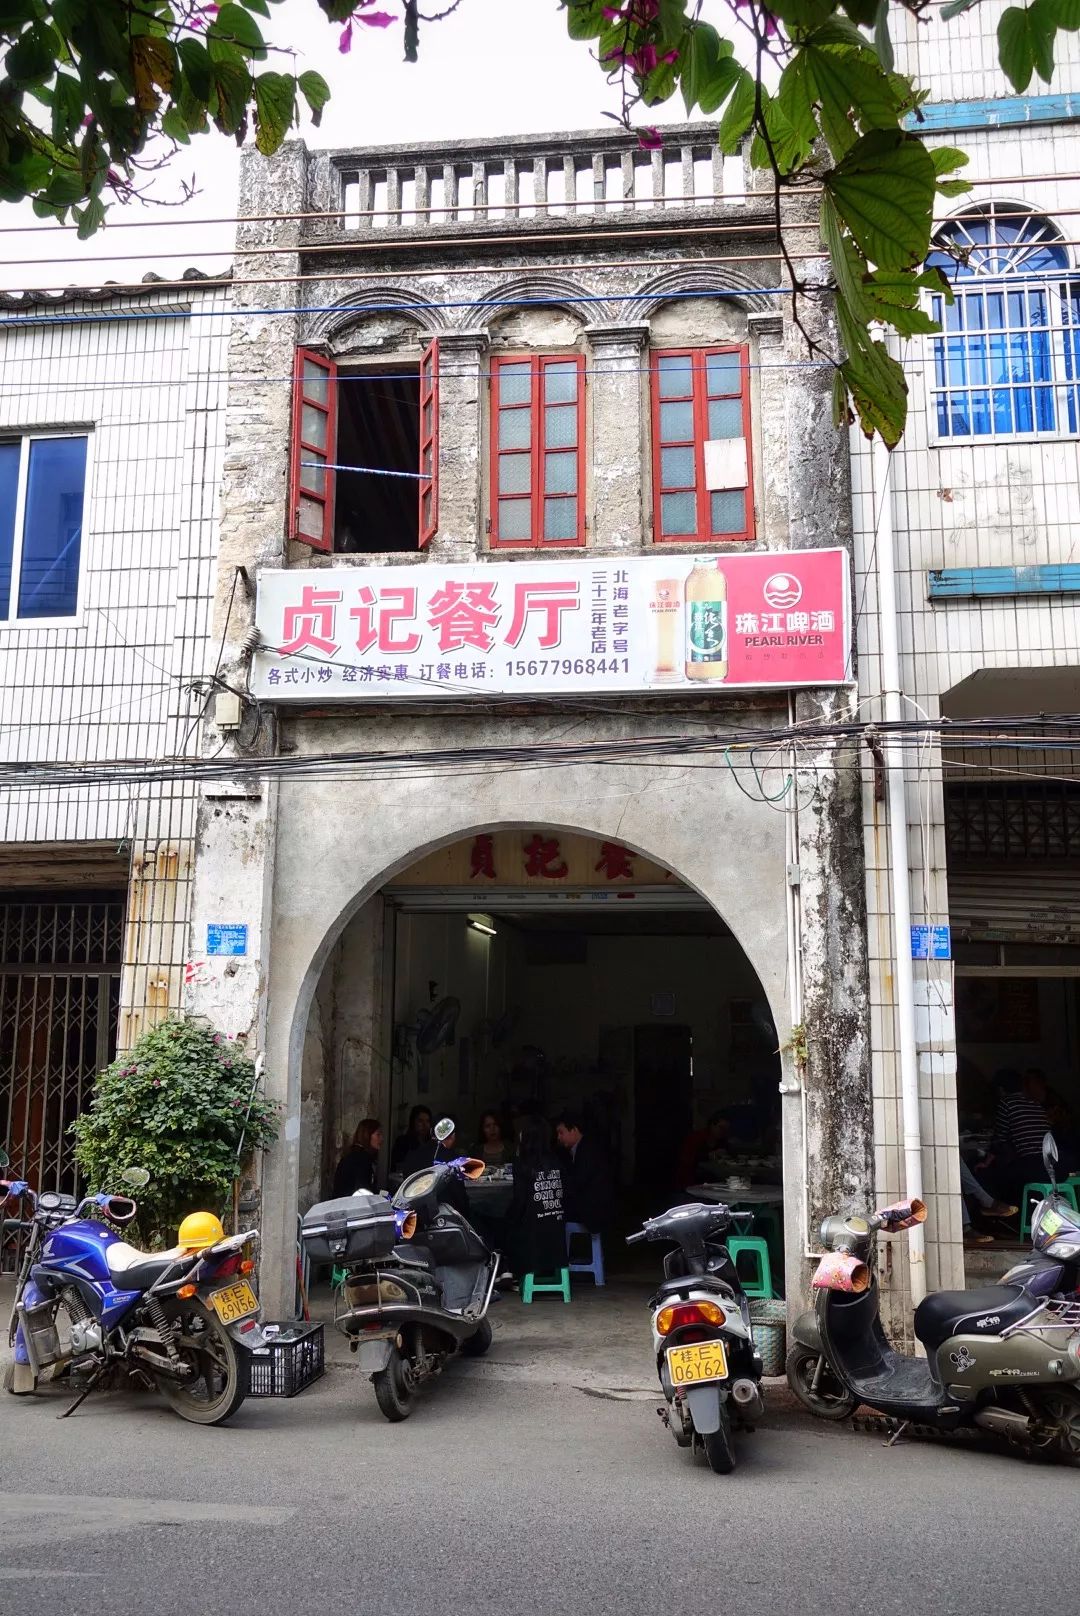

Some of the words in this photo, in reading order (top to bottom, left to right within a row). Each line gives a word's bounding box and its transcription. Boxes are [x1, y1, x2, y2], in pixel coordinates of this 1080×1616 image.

[278, 580, 581, 658] 贞记餐厅
[591, 570, 607, 654] 三十三年老店
[612, 570, 629, 654] 北海老字号
[735, 610, 835, 634] 珠江啤酒
[744, 636, 785, 647] PEARL
[787, 635, 824, 646] RIVER
[267, 666, 333, 685] 各式小炒
[342, 664, 408, 682] 经济实惠
[505, 658, 629, 677] 15677968441
[222, 1296, 255, 1320] 69V56
[675, 1359, 723, 1381] 06Y62
